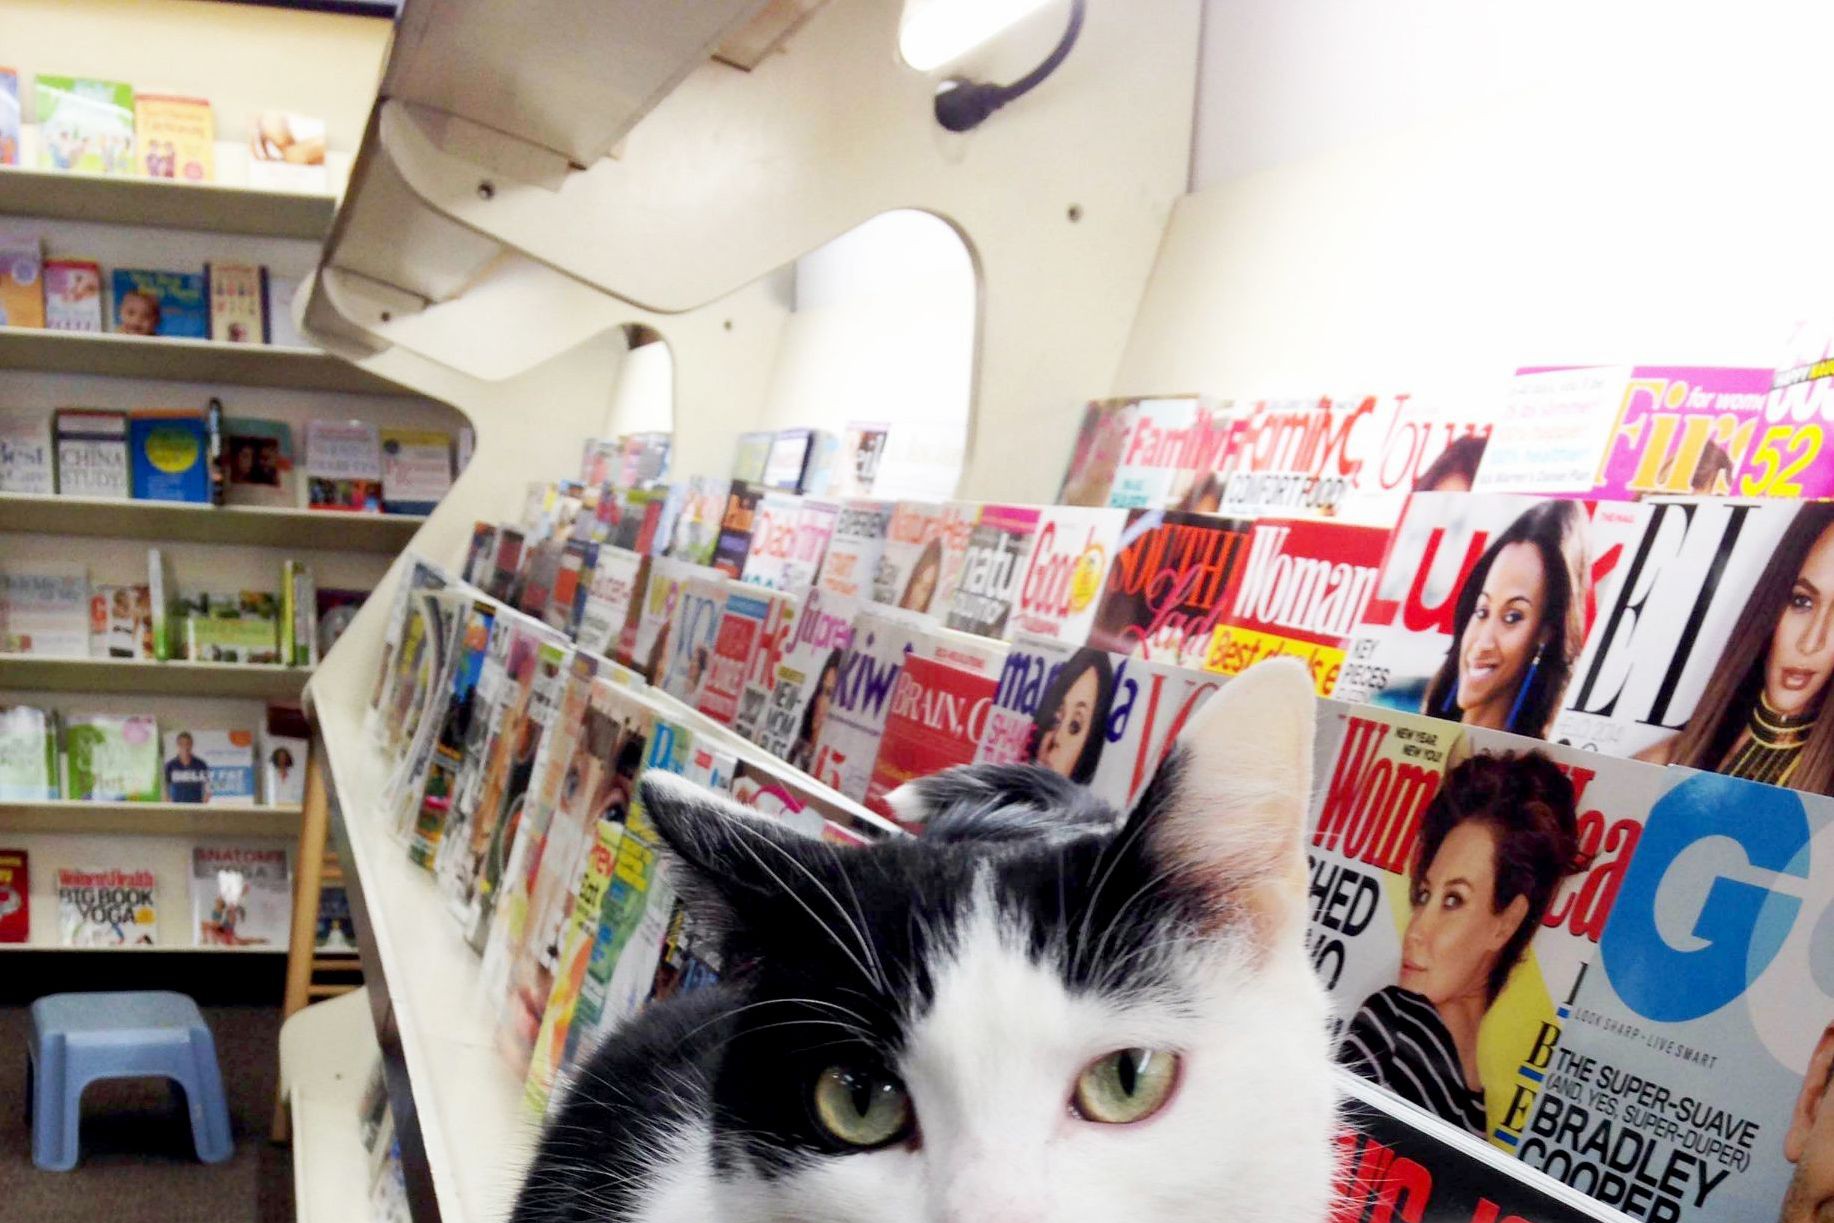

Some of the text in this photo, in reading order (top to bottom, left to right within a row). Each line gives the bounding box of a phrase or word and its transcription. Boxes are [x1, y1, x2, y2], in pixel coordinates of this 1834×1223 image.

[1740, 423, 1824, 497] 52
[78, 902, 137, 925] YOGA
[100, 888, 154, 907] BOOK
[1556, 1046, 1761, 1149] THE SUPER-SUAVE
[1587, 1089, 1620, 1120] YES,
[1622, 1104, 1751, 1174] SUPER-DUPER)
[1530, 1093, 1732, 1209] BRADLEY
